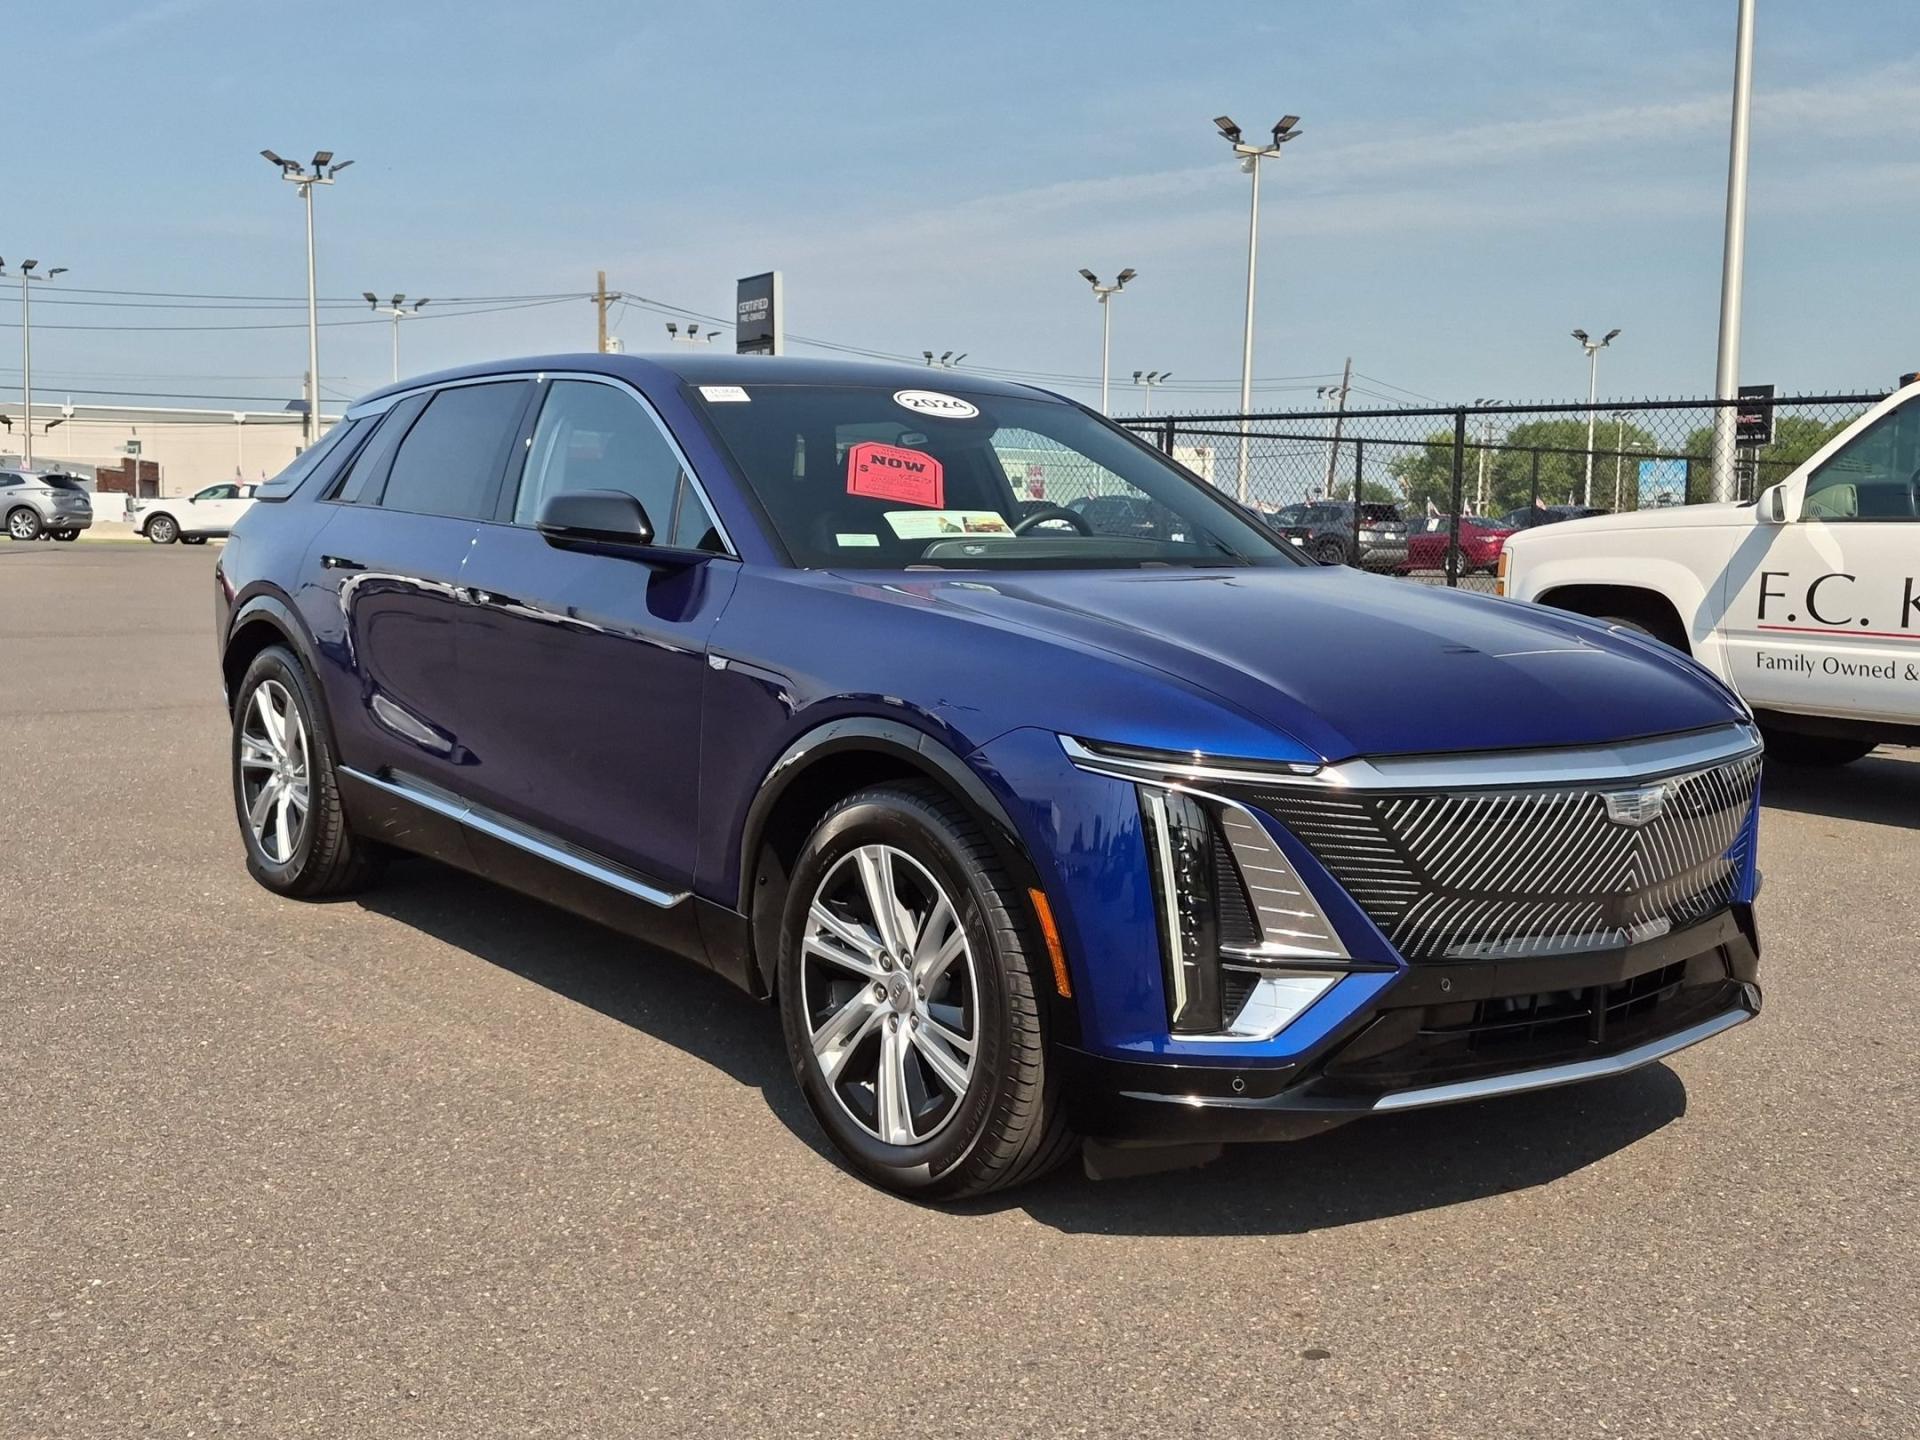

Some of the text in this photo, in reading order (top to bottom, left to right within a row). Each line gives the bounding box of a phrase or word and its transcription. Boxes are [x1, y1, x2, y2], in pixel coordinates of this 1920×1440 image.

[905, 398, 968, 410] 2024
[871, 455, 926, 473] NOW
[1758, 572, 1869, 626] F.C.
[1757, 652, 1919, 681] Family Owned &
